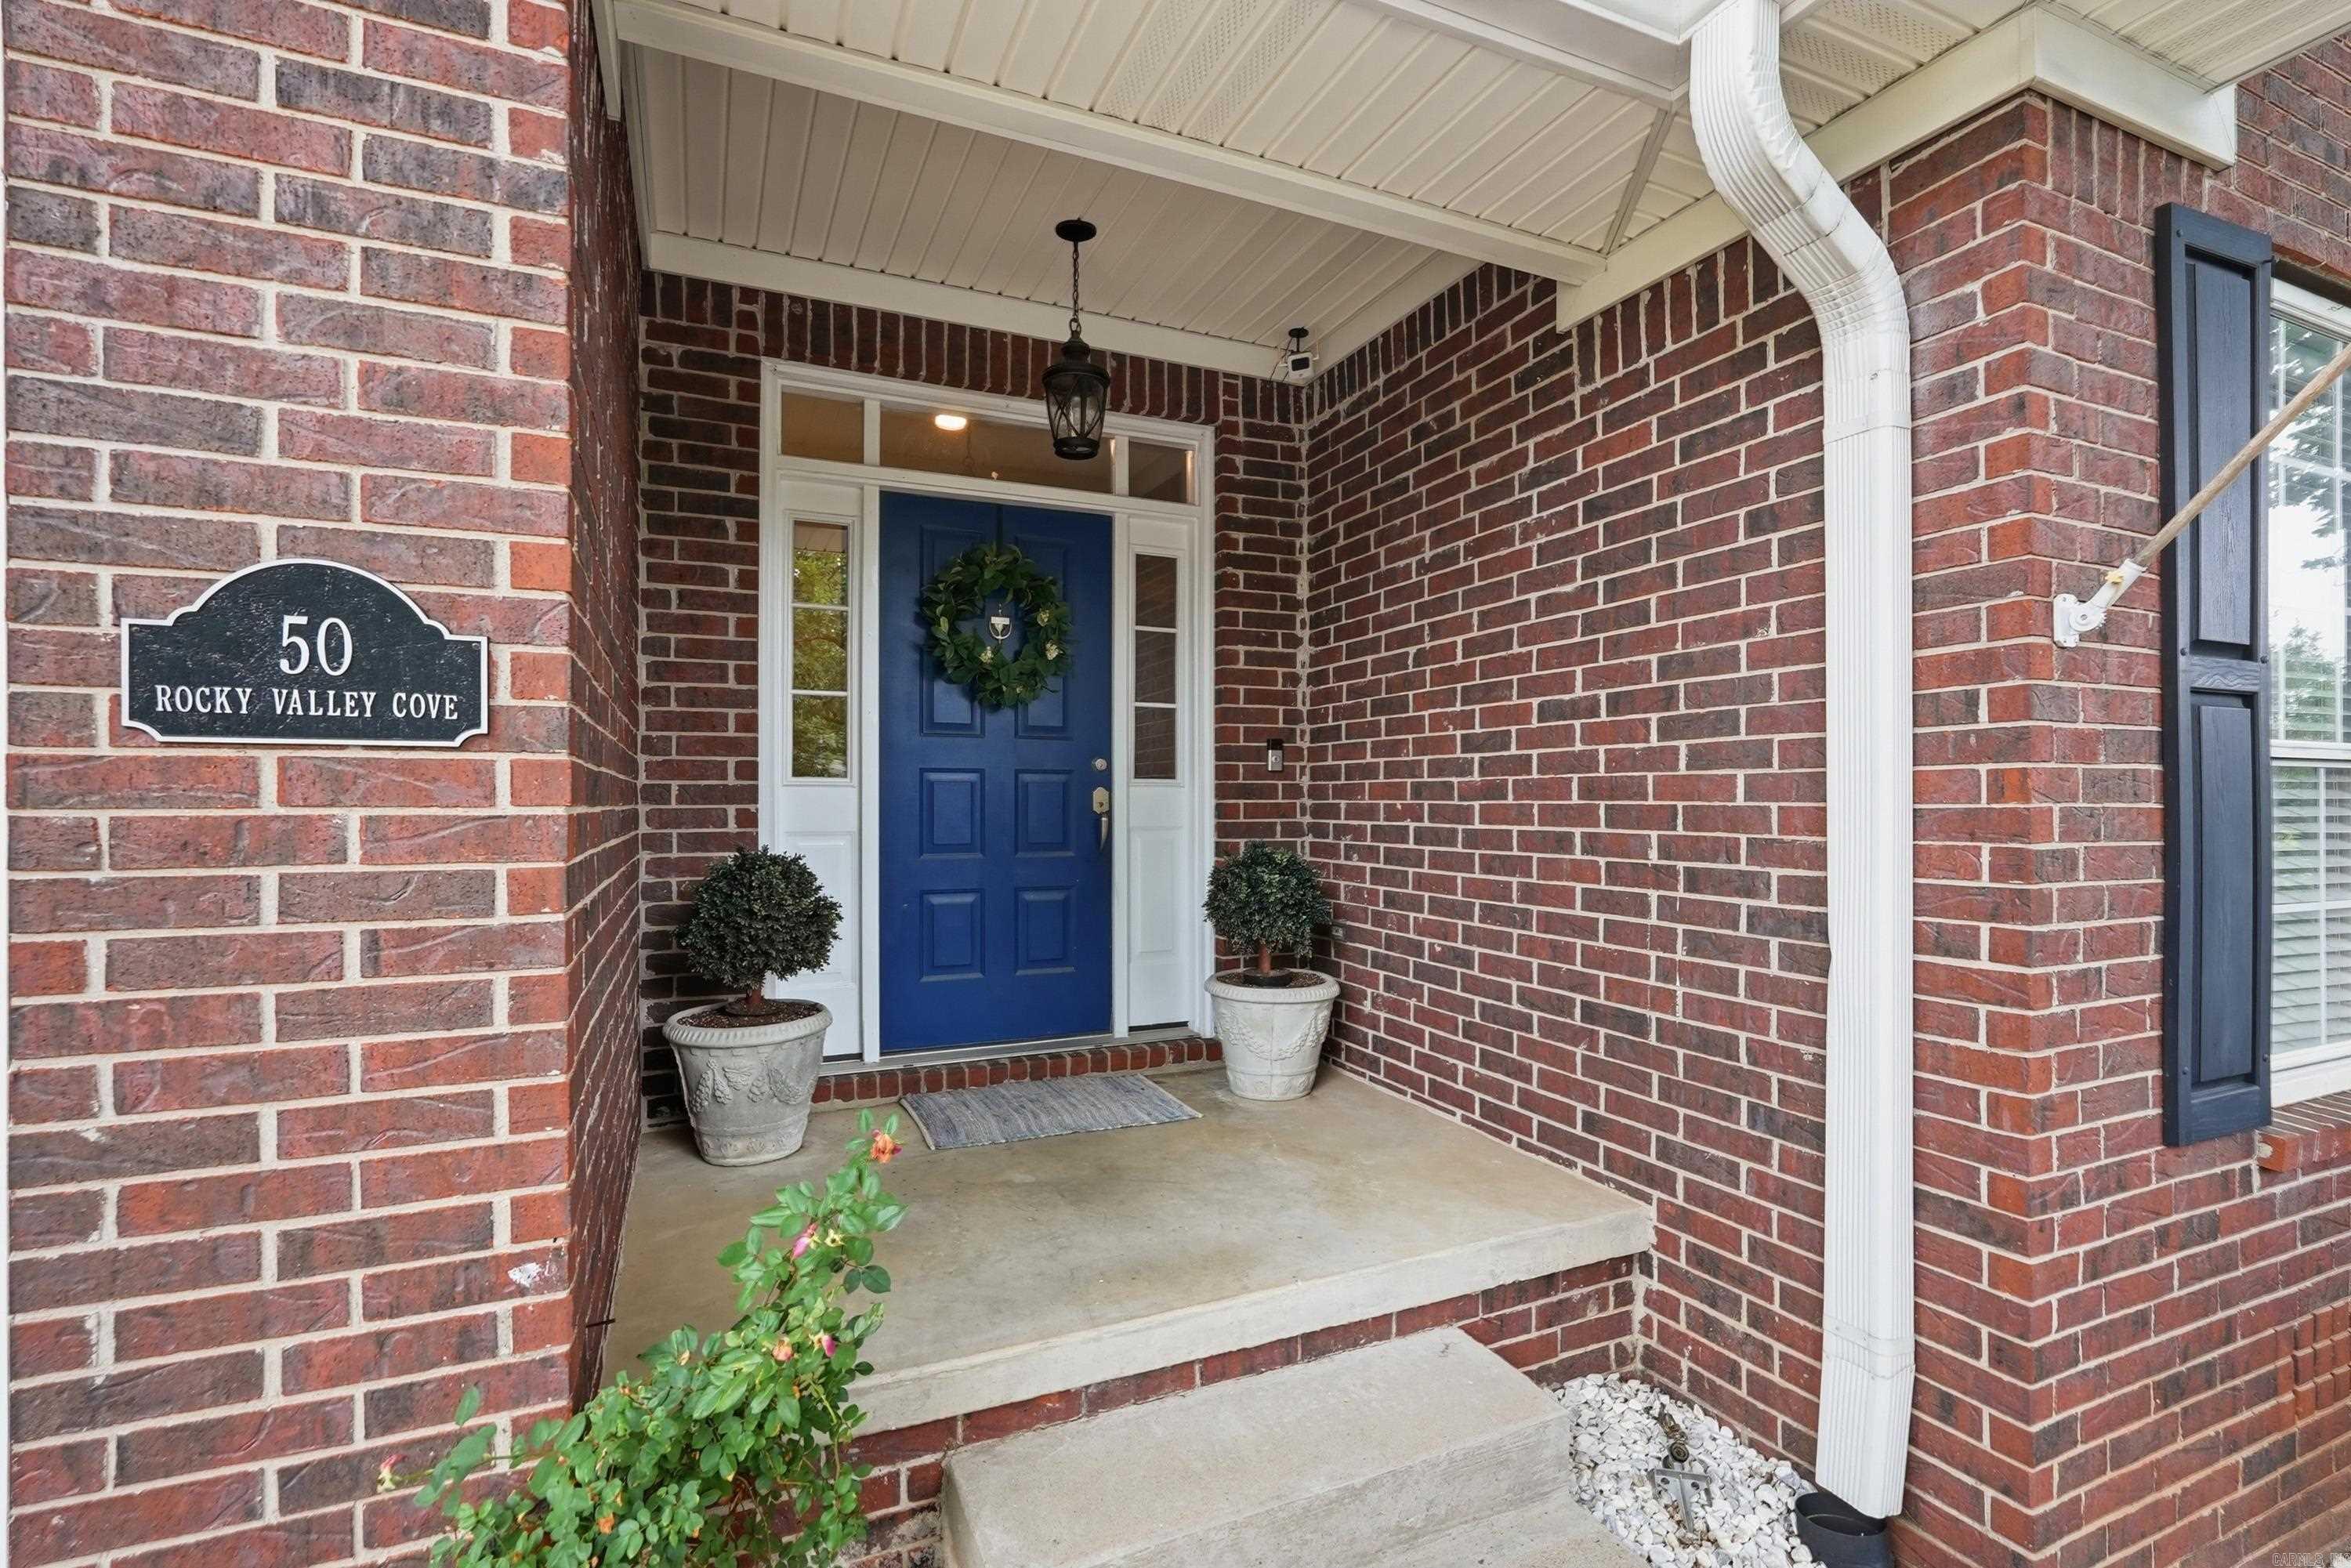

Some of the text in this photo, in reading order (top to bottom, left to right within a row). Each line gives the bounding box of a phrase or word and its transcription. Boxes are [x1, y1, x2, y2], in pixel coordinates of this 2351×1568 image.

[279, 614, 353, 676] 50
[154, 685, 458, 720] ROCKY VALLEY COVE
